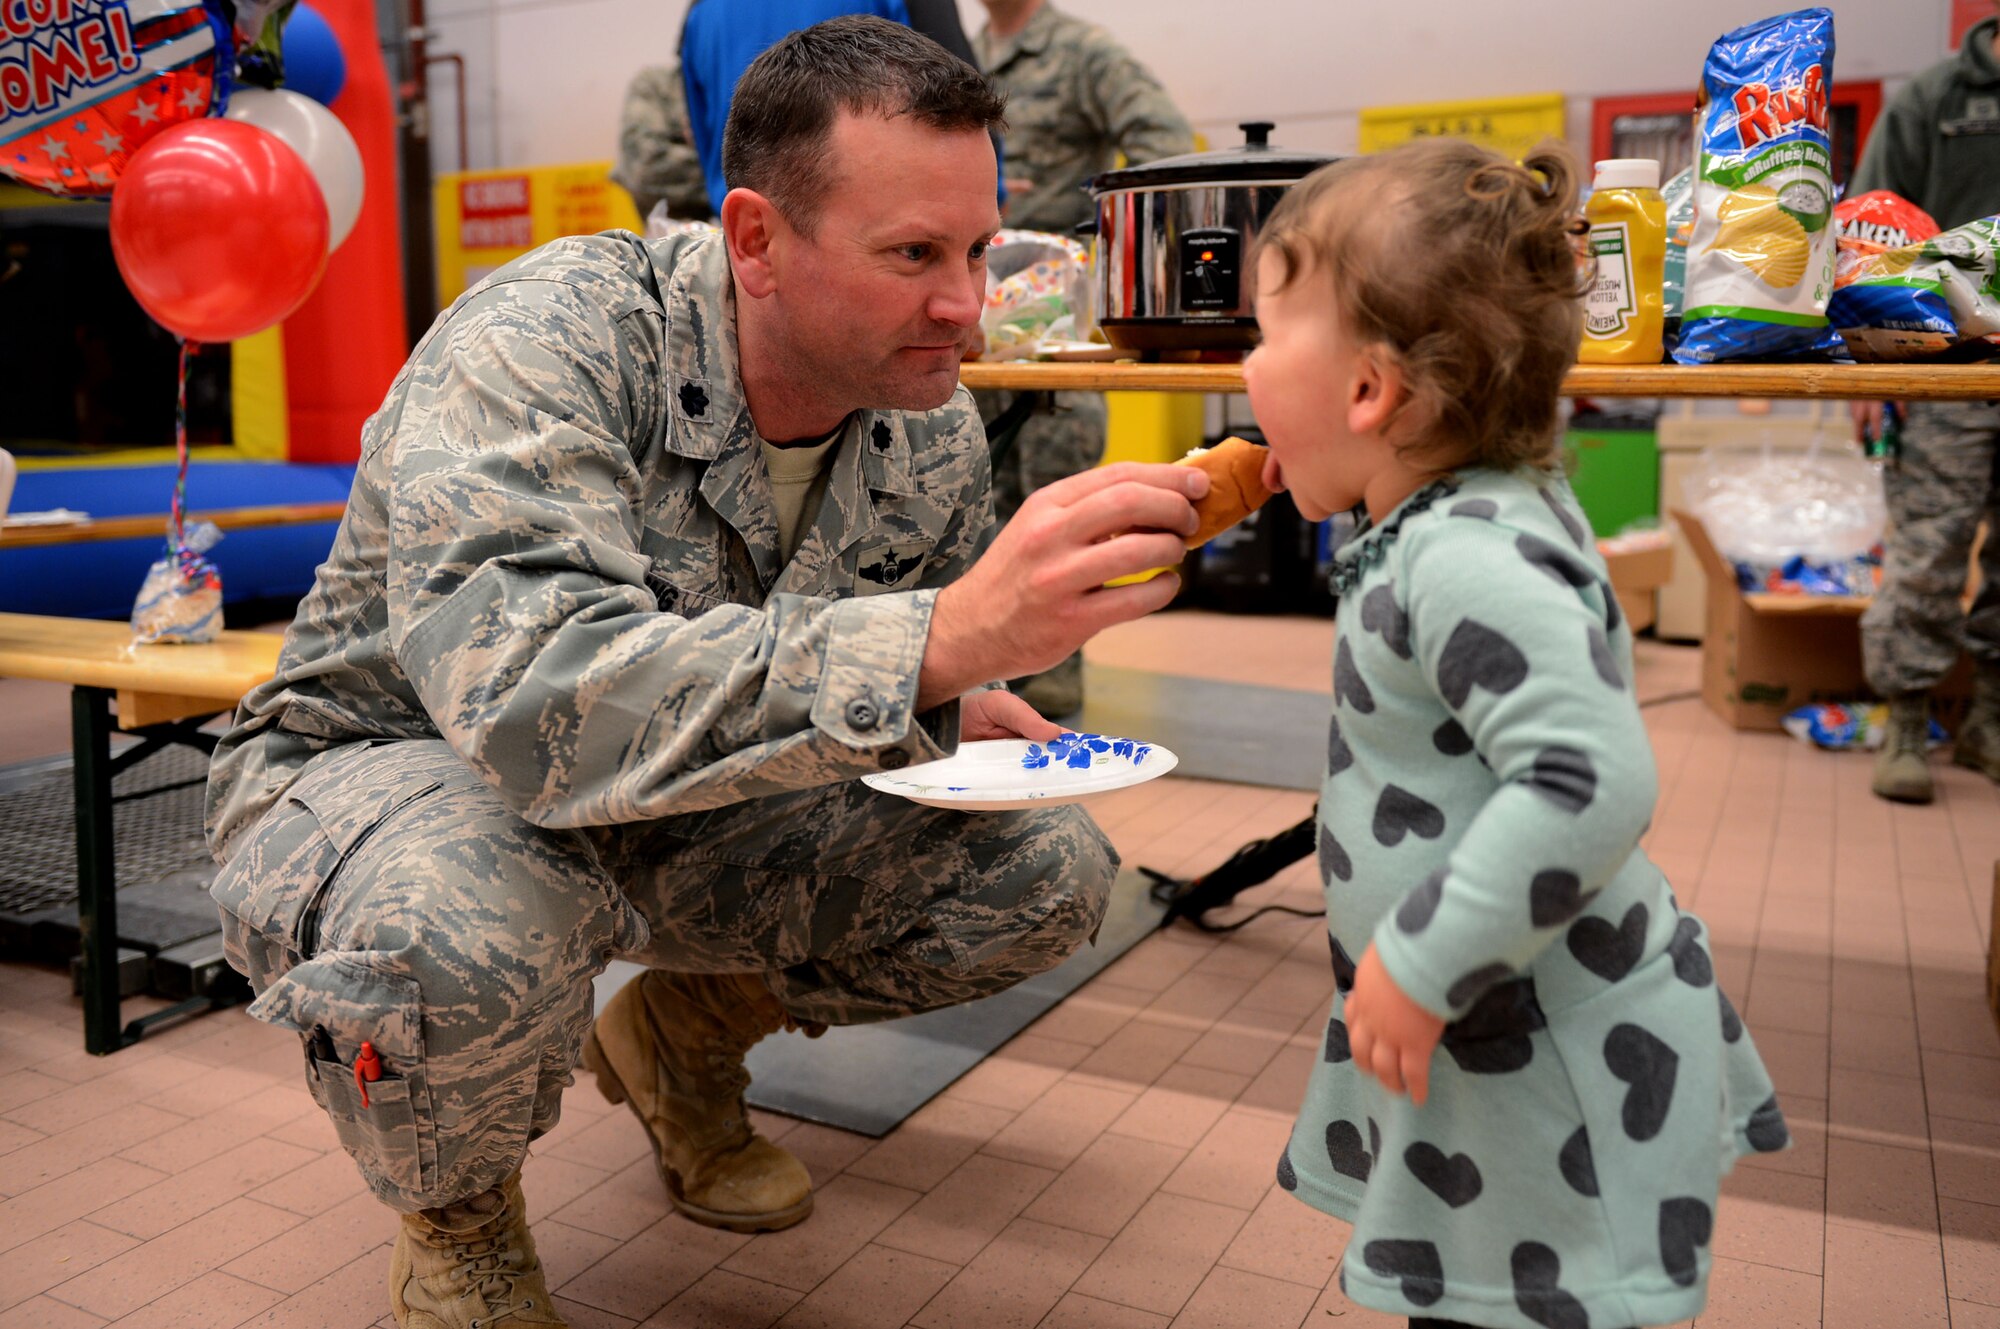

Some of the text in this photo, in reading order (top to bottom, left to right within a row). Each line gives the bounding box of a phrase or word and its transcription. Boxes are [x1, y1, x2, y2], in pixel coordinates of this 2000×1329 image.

[0, 10, 134, 115] OME!
[1590, 292, 1618, 303] YELLOW
[1590, 314, 1616, 329] HEINZ
